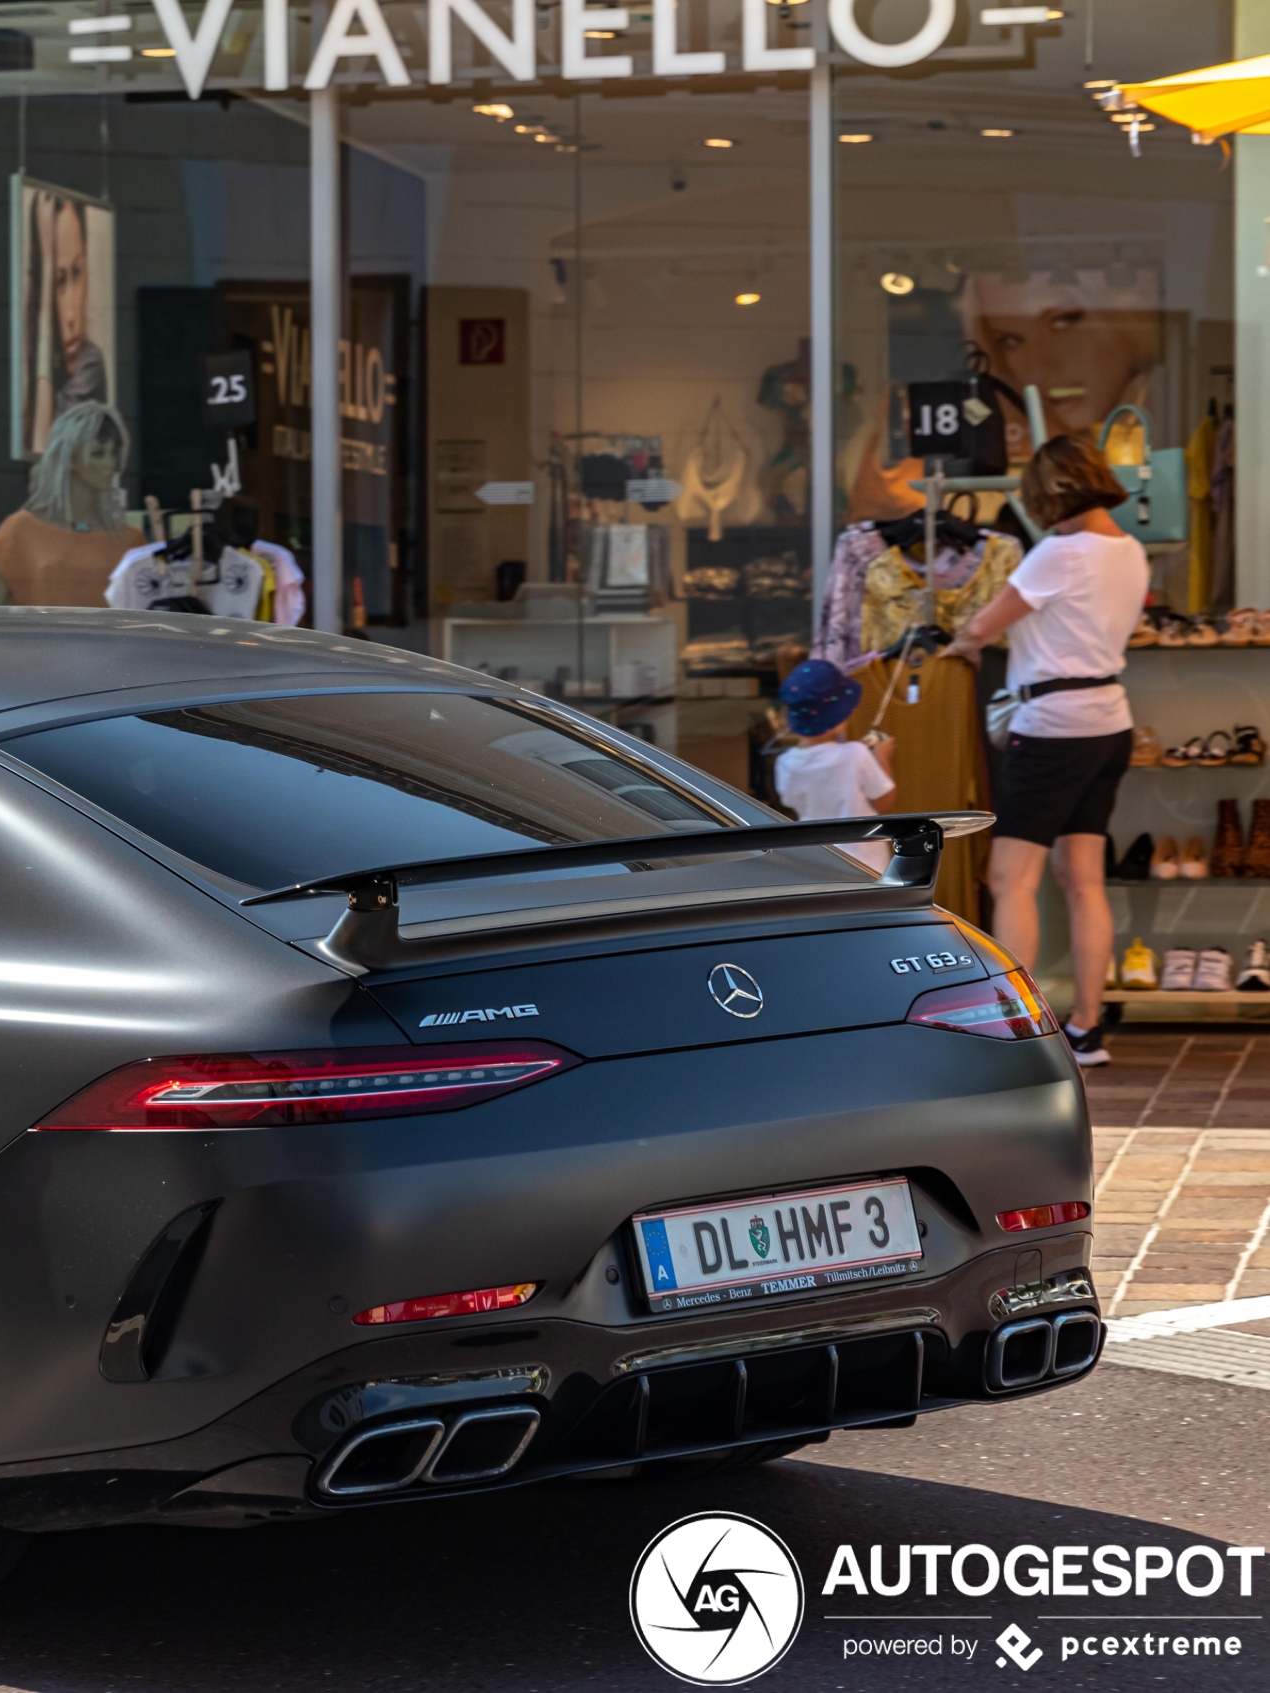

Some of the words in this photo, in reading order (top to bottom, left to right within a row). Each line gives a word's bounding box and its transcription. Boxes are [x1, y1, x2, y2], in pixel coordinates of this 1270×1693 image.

[890, 956, 922, 974] GT
[458, 1003, 540, 1024] AMG
[692, 1217, 749, 1276] DL
[774, 1200, 853, 1263] HMF
[864, 1195, 890, 1249] 3
[657, 1264, 669, 1282] A
[676, 1292, 721, 1307] Mercedes
[729, 1286, 753, 1300] Benz
[760, 1275, 817, 1294] TEMMER
